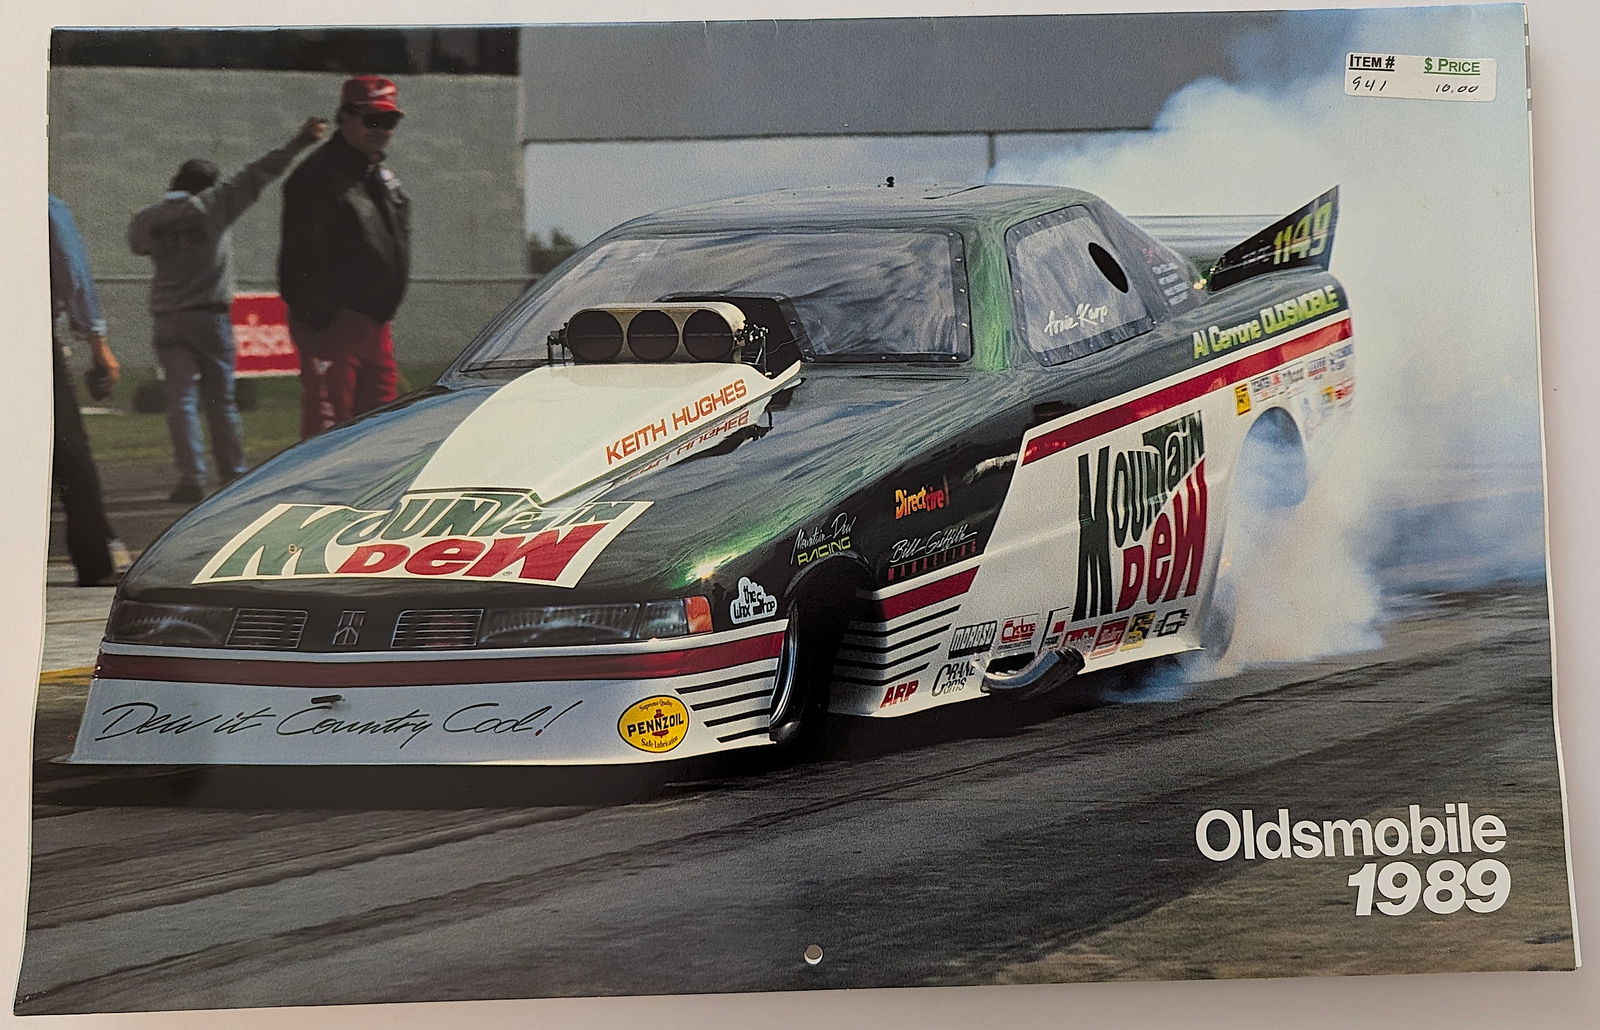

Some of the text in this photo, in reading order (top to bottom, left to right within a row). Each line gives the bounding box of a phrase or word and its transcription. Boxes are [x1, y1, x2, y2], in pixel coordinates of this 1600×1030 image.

[1349, 54, 1396, 69] ITEM #
[1424, 57, 1481, 73] $ PRICE
[1435, 83, 1479, 94] 10.00
[605, 378, 748, 466] KEITH HUGHES
[797, 536, 851, 566] RACING
[889, 538, 926, 563] Bill
[880, 679, 919, 708] ARP
[95, 700, 583, 749] Dew it Country Cool!
[627, 713, 684, 737] PENNZOIL
[1195, 802, 1508, 862] Oldsmobile
[1347, 858, 1512, 917] 1989
